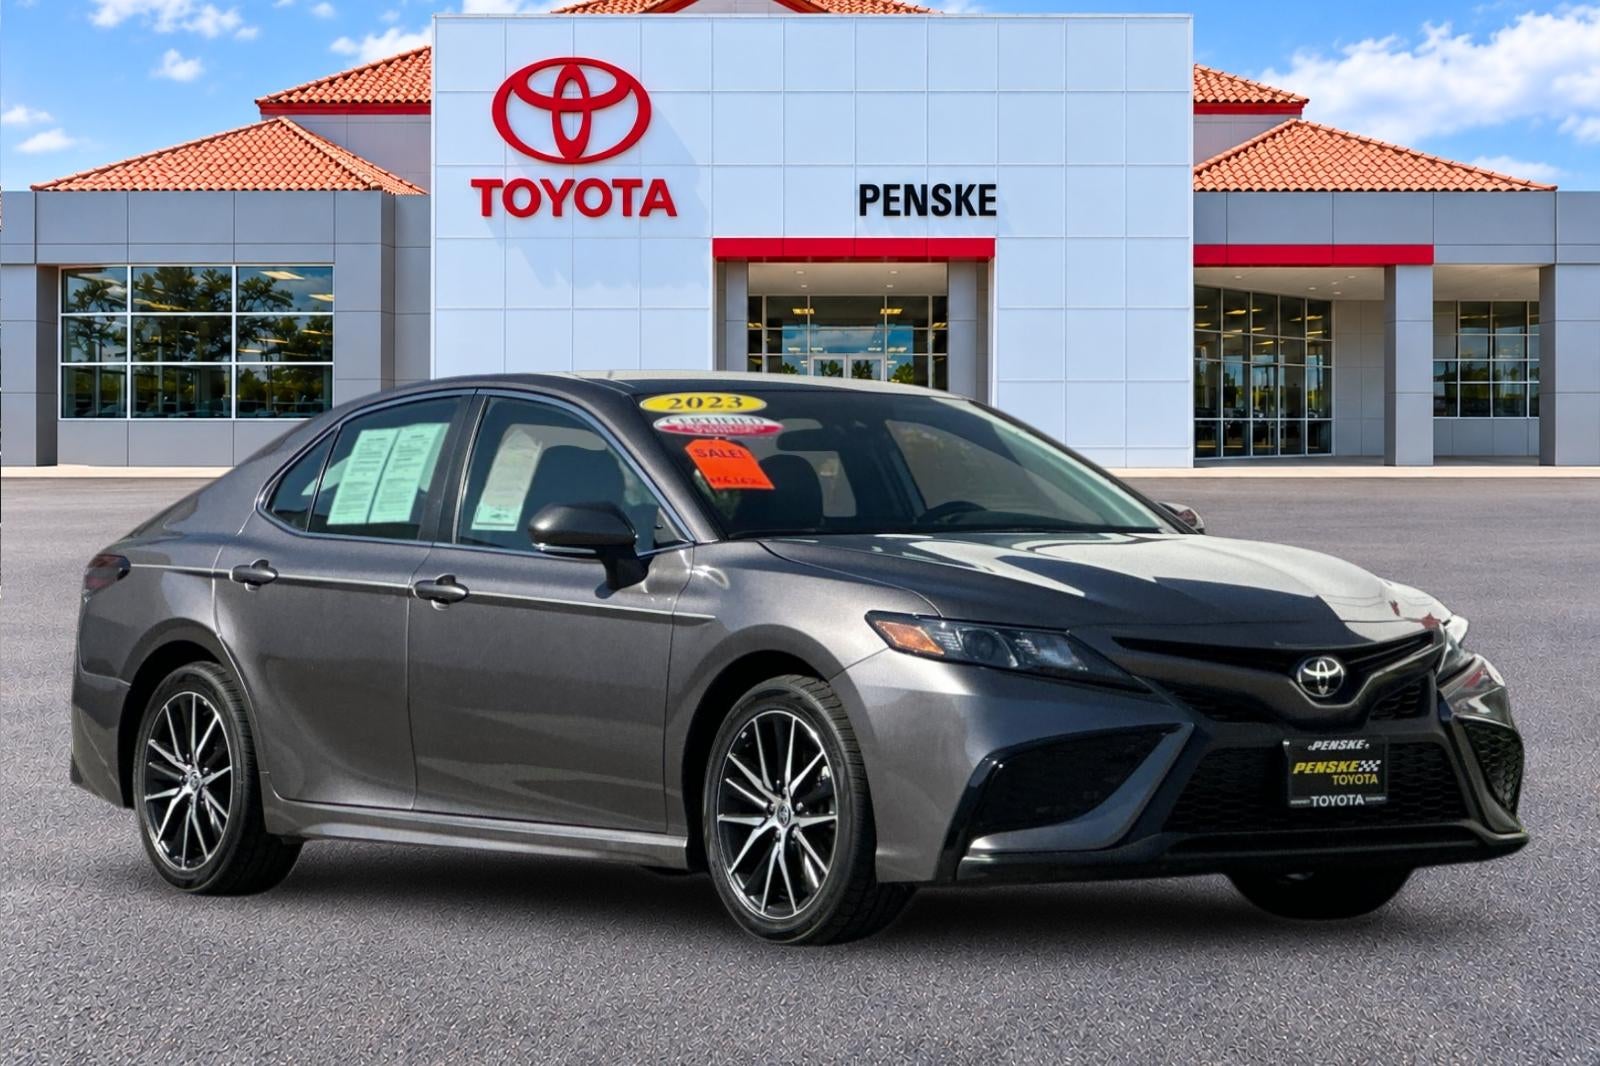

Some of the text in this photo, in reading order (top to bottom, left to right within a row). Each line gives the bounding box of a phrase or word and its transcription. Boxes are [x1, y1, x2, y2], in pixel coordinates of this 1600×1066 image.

[470, 178, 678, 218] TOYOTA
[858, 183, 997, 217] PENSKE
[667, 396, 744, 410] 2023
[1311, 739, 1366, 751] PENSKE
[1293, 761, 1360, 774] PENSKE
[1333, 774, 1378, 785] TOYOTA
[1311, 795, 1365, 807] TOYOTA
